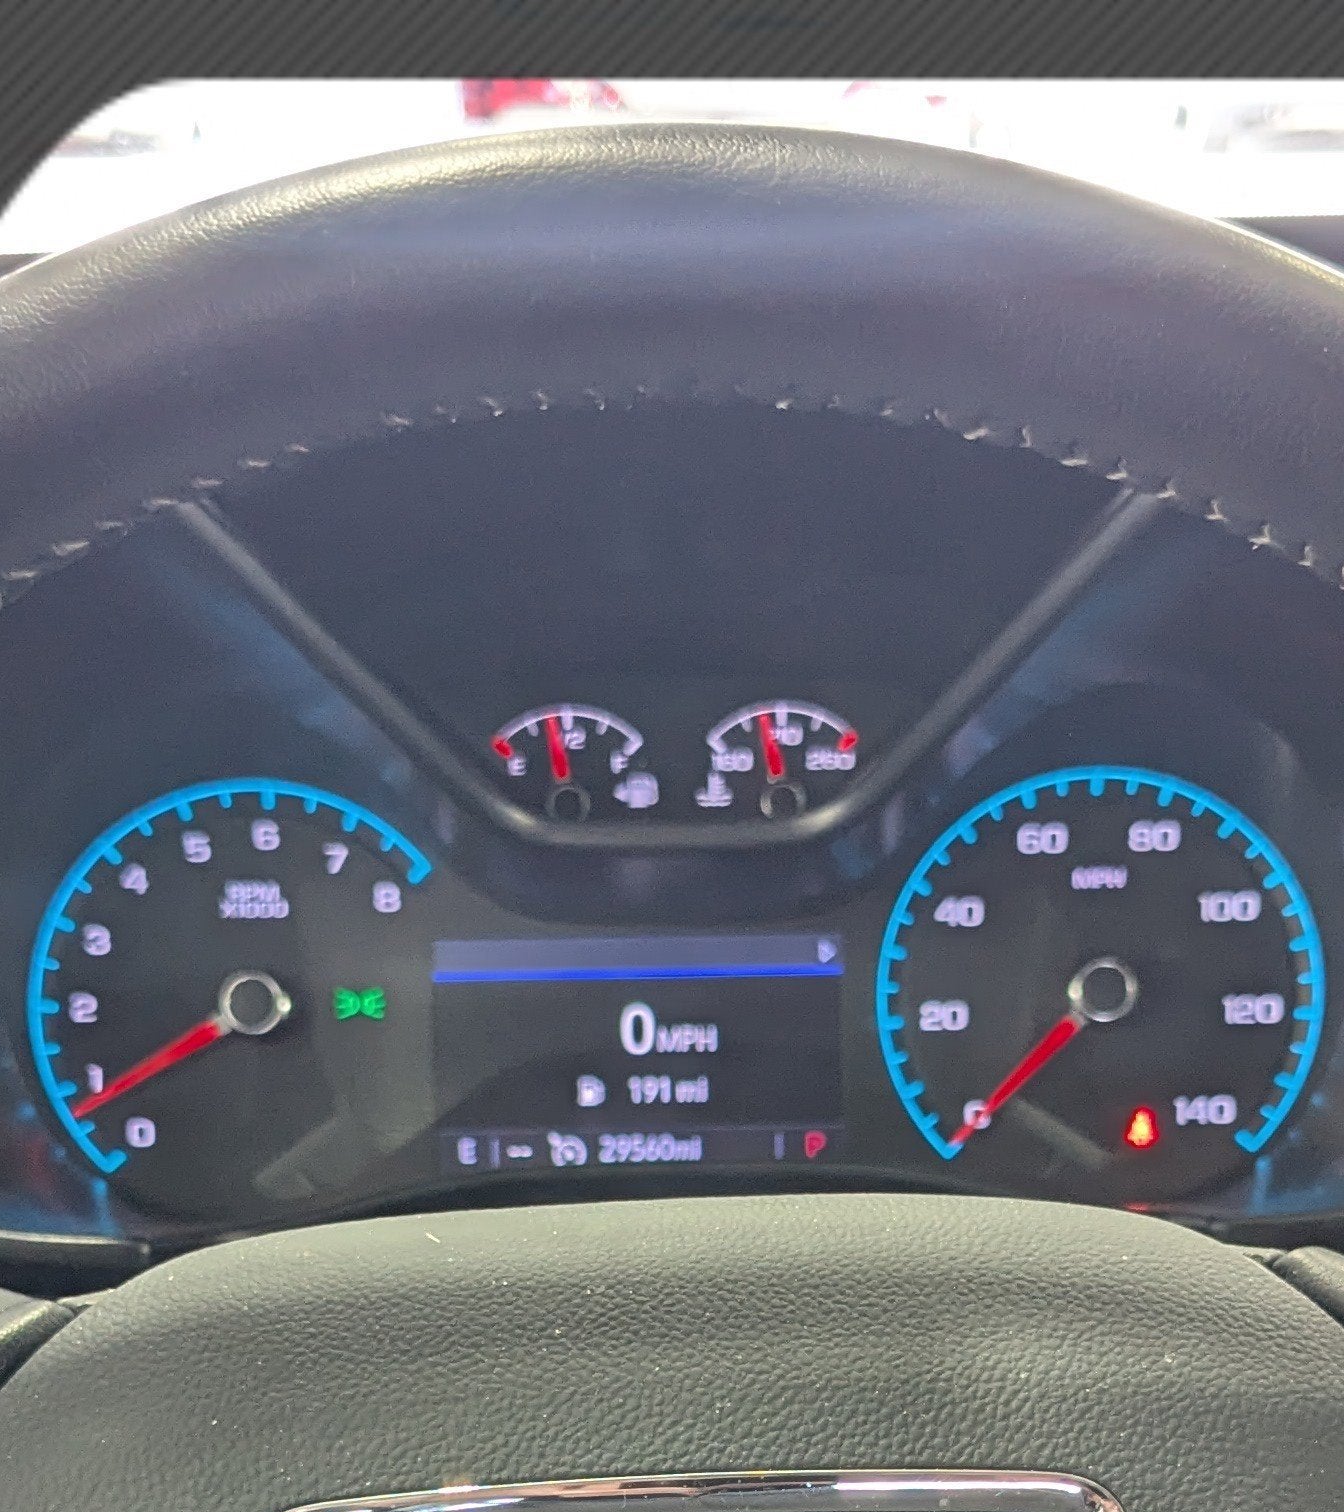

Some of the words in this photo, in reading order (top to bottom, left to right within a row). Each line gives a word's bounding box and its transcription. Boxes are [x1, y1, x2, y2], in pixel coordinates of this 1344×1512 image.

[181, 831, 212, 863] 5
[251, 818, 280, 851] 6
[1016, 822, 1069, 854] 60
[1128, 821, 1181, 852] 80
[322, 841, 349, 874] 7
[119, 863, 149, 895] 4
[1071, 866, 1128, 889] MPH
[372, 880, 402, 913] 8
[934, 896, 985, 927] 40
[1198, 891, 1261, 922] 100
[82, 923, 112, 956] 3
[68, 992, 98, 1023] 2
[919, 1001, 969, 1031] 20
[1222, 994, 1285, 1025] 120
[87, 1063, 103, 1093] 1
[627, 1076, 672, 1103] 191
[1173, 1095, 1237, 1125] 140
[125, 1117, 156, 1148] 0
